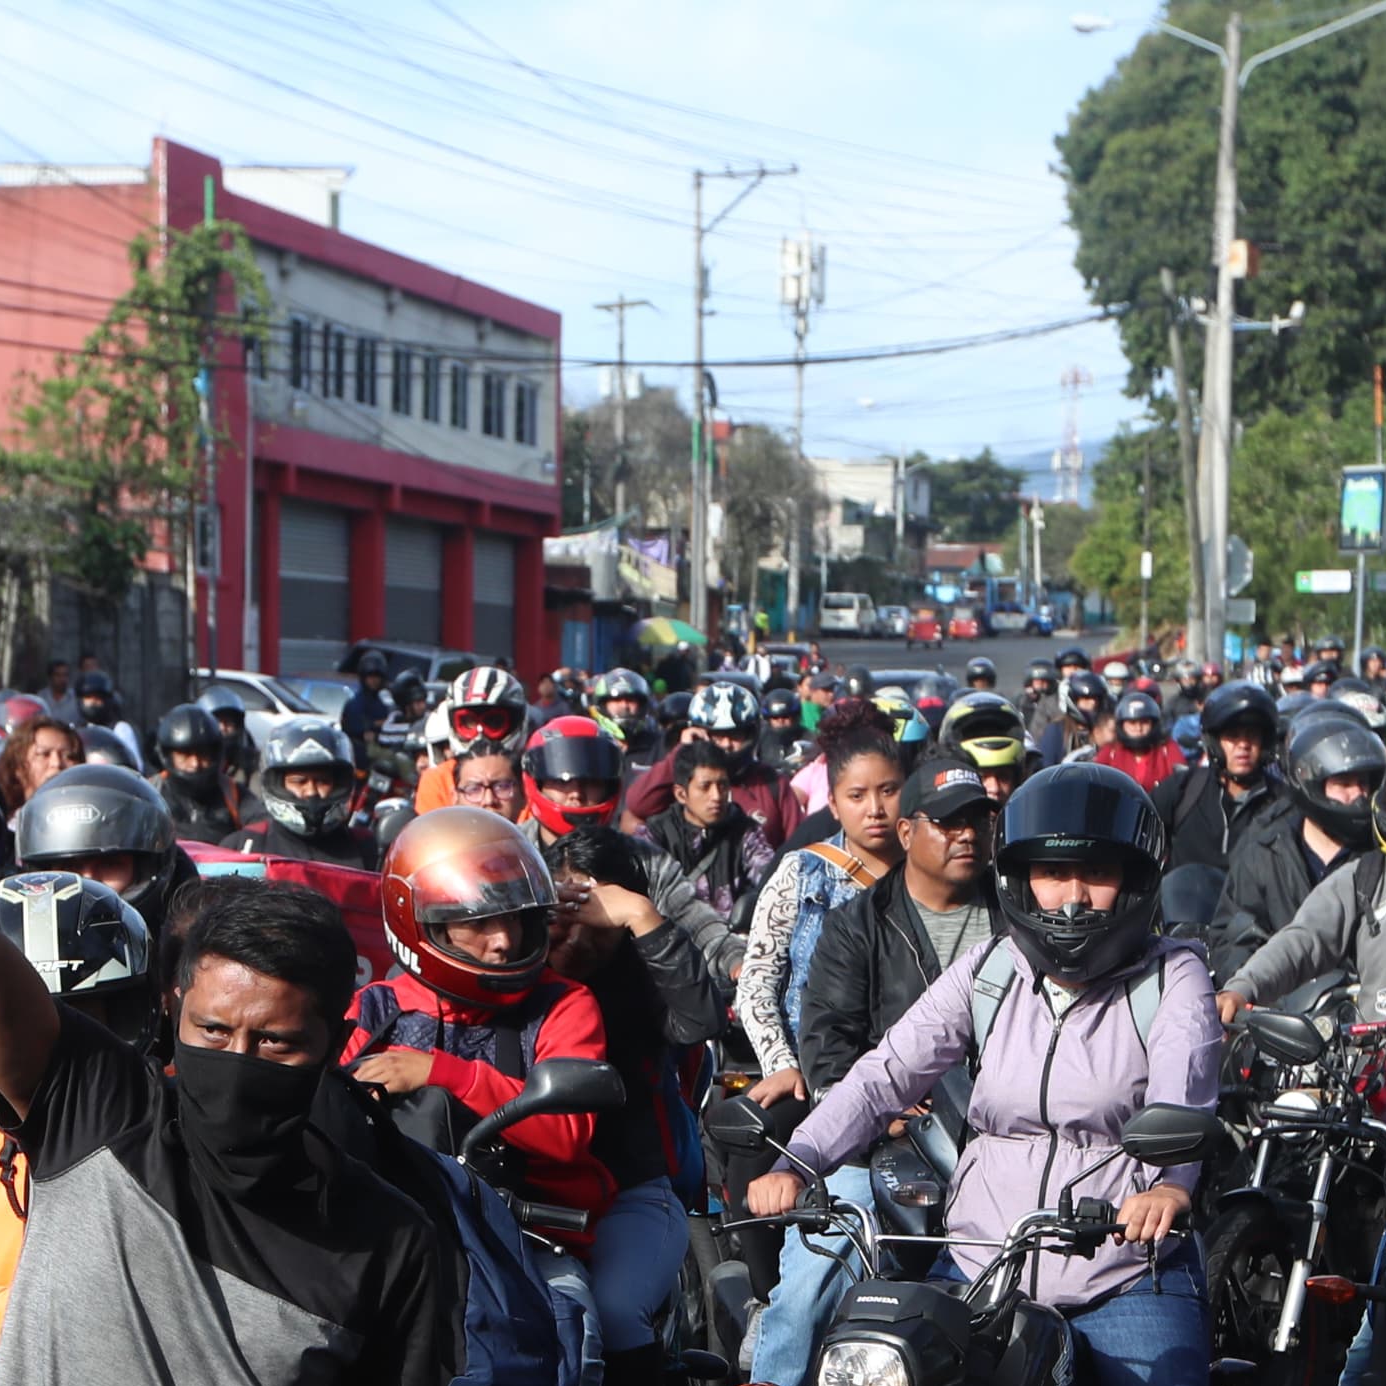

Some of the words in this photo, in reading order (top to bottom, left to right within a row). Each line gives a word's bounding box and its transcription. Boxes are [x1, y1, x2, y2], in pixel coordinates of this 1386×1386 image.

[1044, 839, 1096, 848] SHAFT
[32, 960, 85, 973] AFT
[856, 1295, 899, 1305] HONDA
